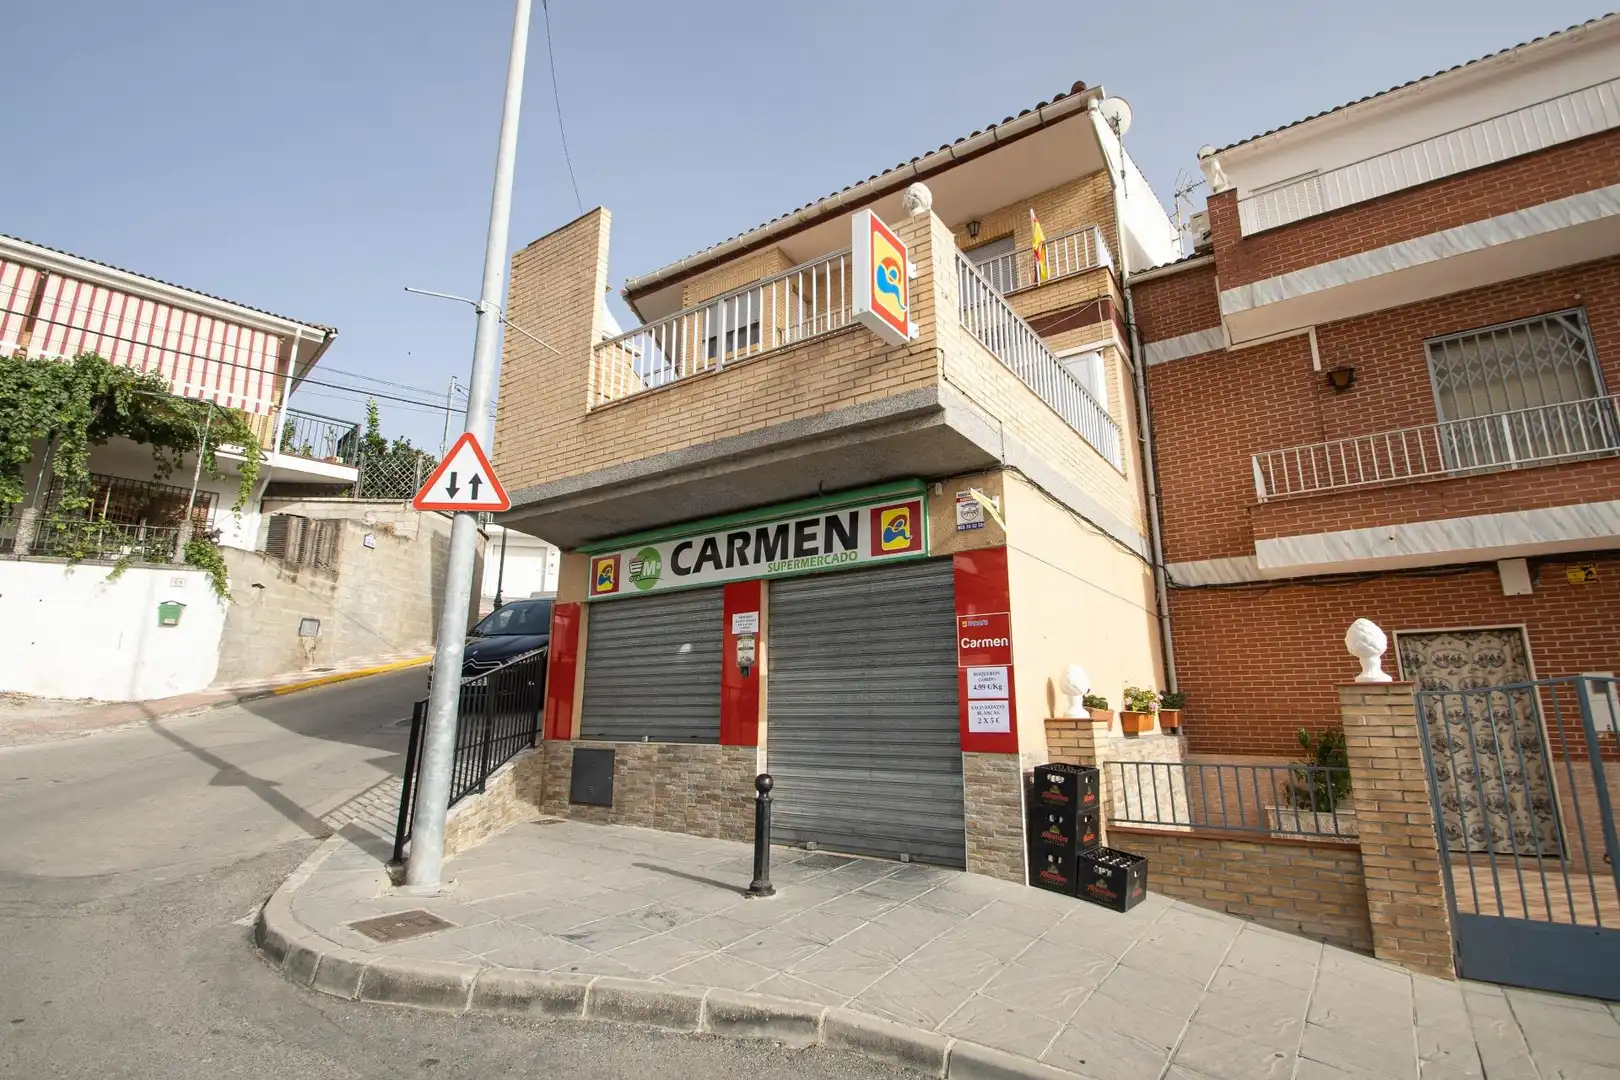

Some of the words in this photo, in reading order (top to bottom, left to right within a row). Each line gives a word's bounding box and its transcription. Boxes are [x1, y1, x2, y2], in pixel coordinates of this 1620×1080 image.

[670, 511, 859, 576] CARMEN
[767, 551, 858, 572] SUPERMERCADO
[961, 637, 1008, 648] Carmen
